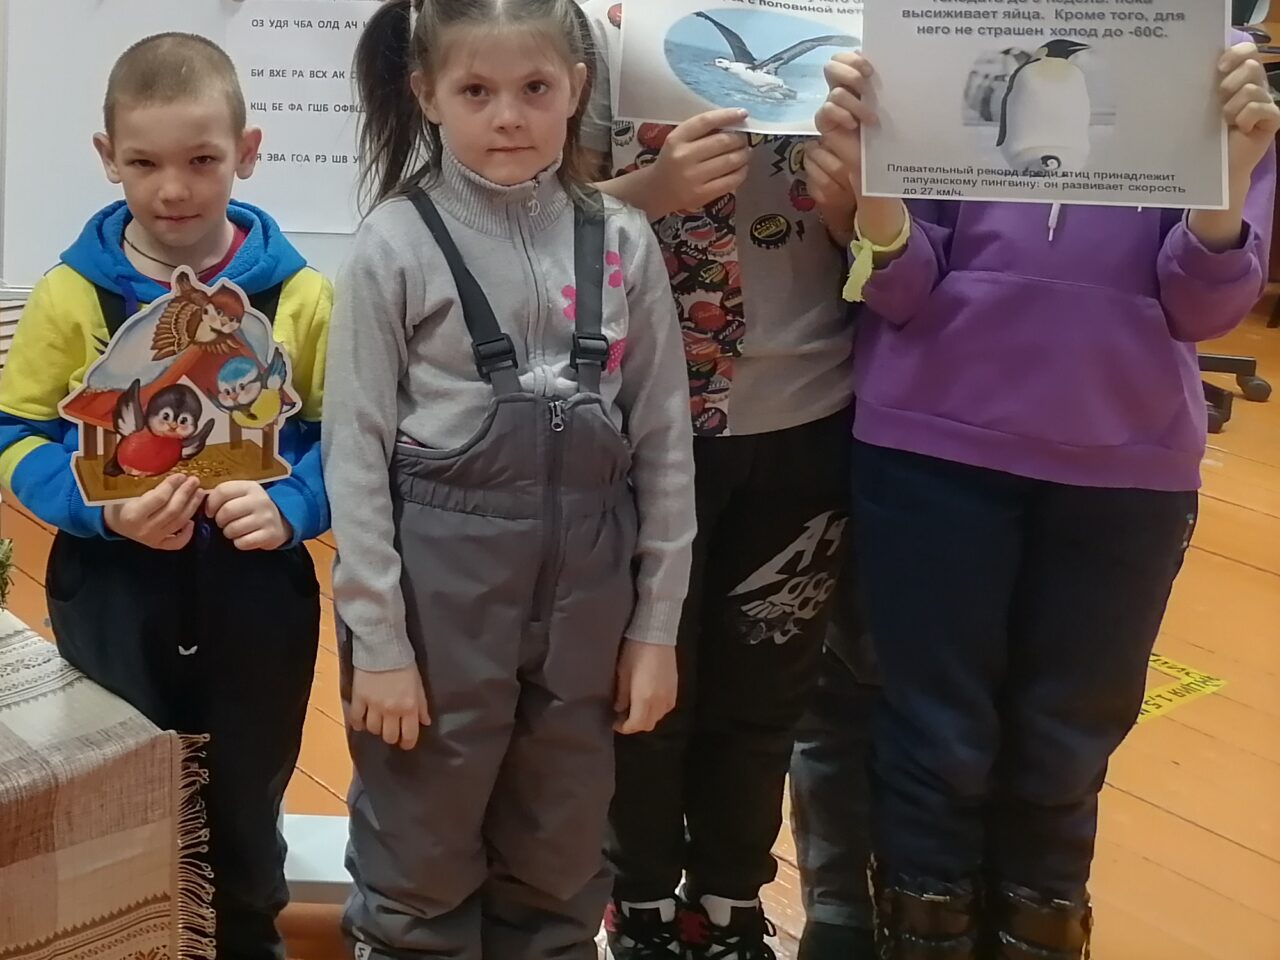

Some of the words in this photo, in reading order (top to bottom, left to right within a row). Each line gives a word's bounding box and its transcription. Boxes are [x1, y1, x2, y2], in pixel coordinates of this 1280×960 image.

[901, 7, 999, 20] высиживает
[1001, 7, 1046, 21] яйца.
[1054, 8, 1106, 22] Кроме
[1109, 10, 1149, 22] того,
[1152, 11, 1186, 22] для
[269, 19, 289, 29] УДЯ
[293, 20, 313, 29] ЧБА
[317, 20, 340, 31] ОЛД
[344, 20, 358, 30] АЧ
[916, 24, 951, 36] него
[954, 25, 973, 36] не
[976, 25, 1044, 38] страшен
[1048, 26, 1097, 38] холод
[1101, 26, 1123, 38] до
[1127, 26, 1169, 39] -60С.
[250, 68, 264, 78] БИ
[269, 69, 287, 78] ВХЕ
[291, 69, 305, 79] РА
[309, 69, 327, 79] ВСХ
[331, 70, 345, 79] АК
[250, 102, 266, 113] КЩ
[271, 102, 284, 112] БЕ
[287, 103, 303, 112] ФА
[308, 103, 329, 113] ГШБ
[266, 153, 286, 162] ЭВА
[291, 153, 310, 163] ГОА
[315, 154, 327, 164] РЭ
[331, 155, 348, 164] ШВ
[886, 163, 974, 176] Плавательный
[976, 167, 1019, 178] рекорд
[1093, 171, 1176, 182] принадлежит
[902, 175, 978, 187] папуанскому
[980, 177, 1041, 189] пингвину:
[1043, 180, 1060, 189] он
[1062, 181, 1126, 192] развивает
[1128, 183, 1187, 194] скорость
[902, 186, 918, 196] до
[919, 186, 934, 196] 27
